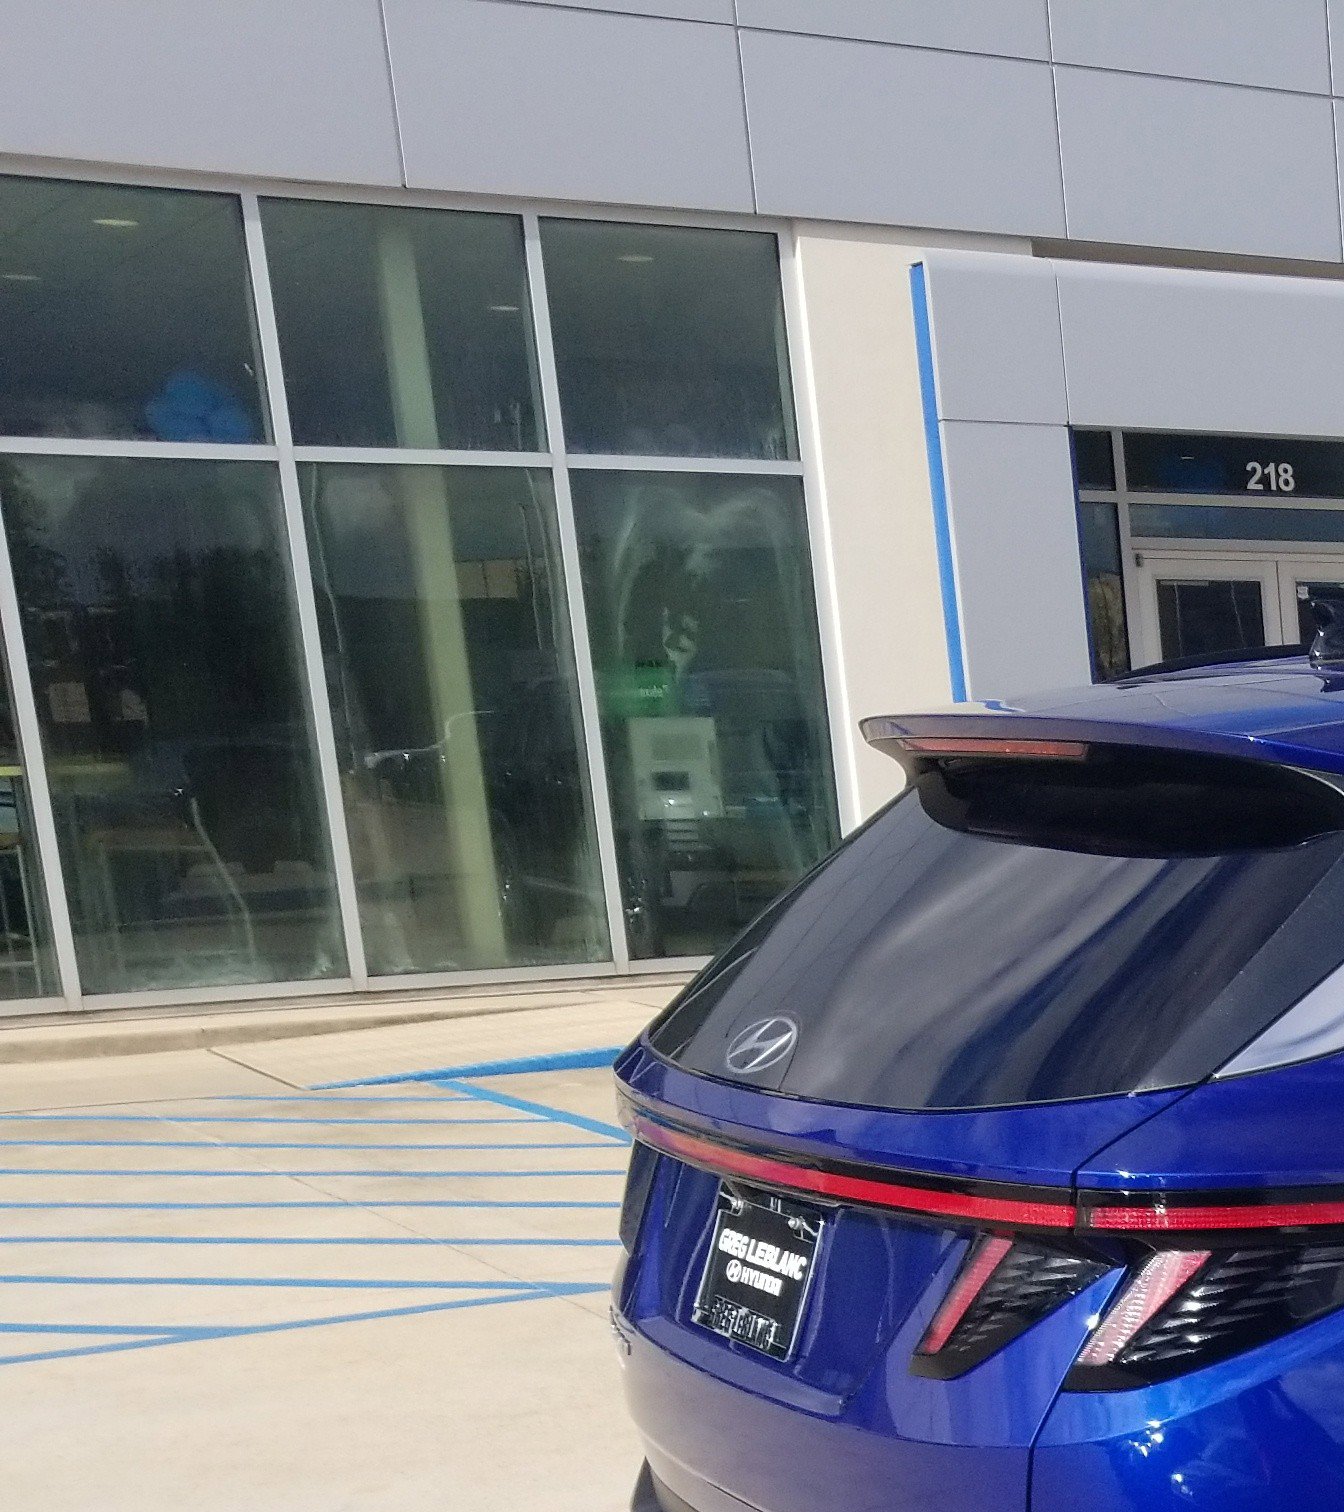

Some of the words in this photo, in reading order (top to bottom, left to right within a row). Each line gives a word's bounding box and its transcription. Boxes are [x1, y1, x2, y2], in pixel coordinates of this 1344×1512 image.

[1245, 461, 1296, 492] 218
[718, 1228, 750, 1259] GREG
[745, 1238, 808, 1281] LEBLANC
[740, 1266, 784, 1297] HYUNDAI
